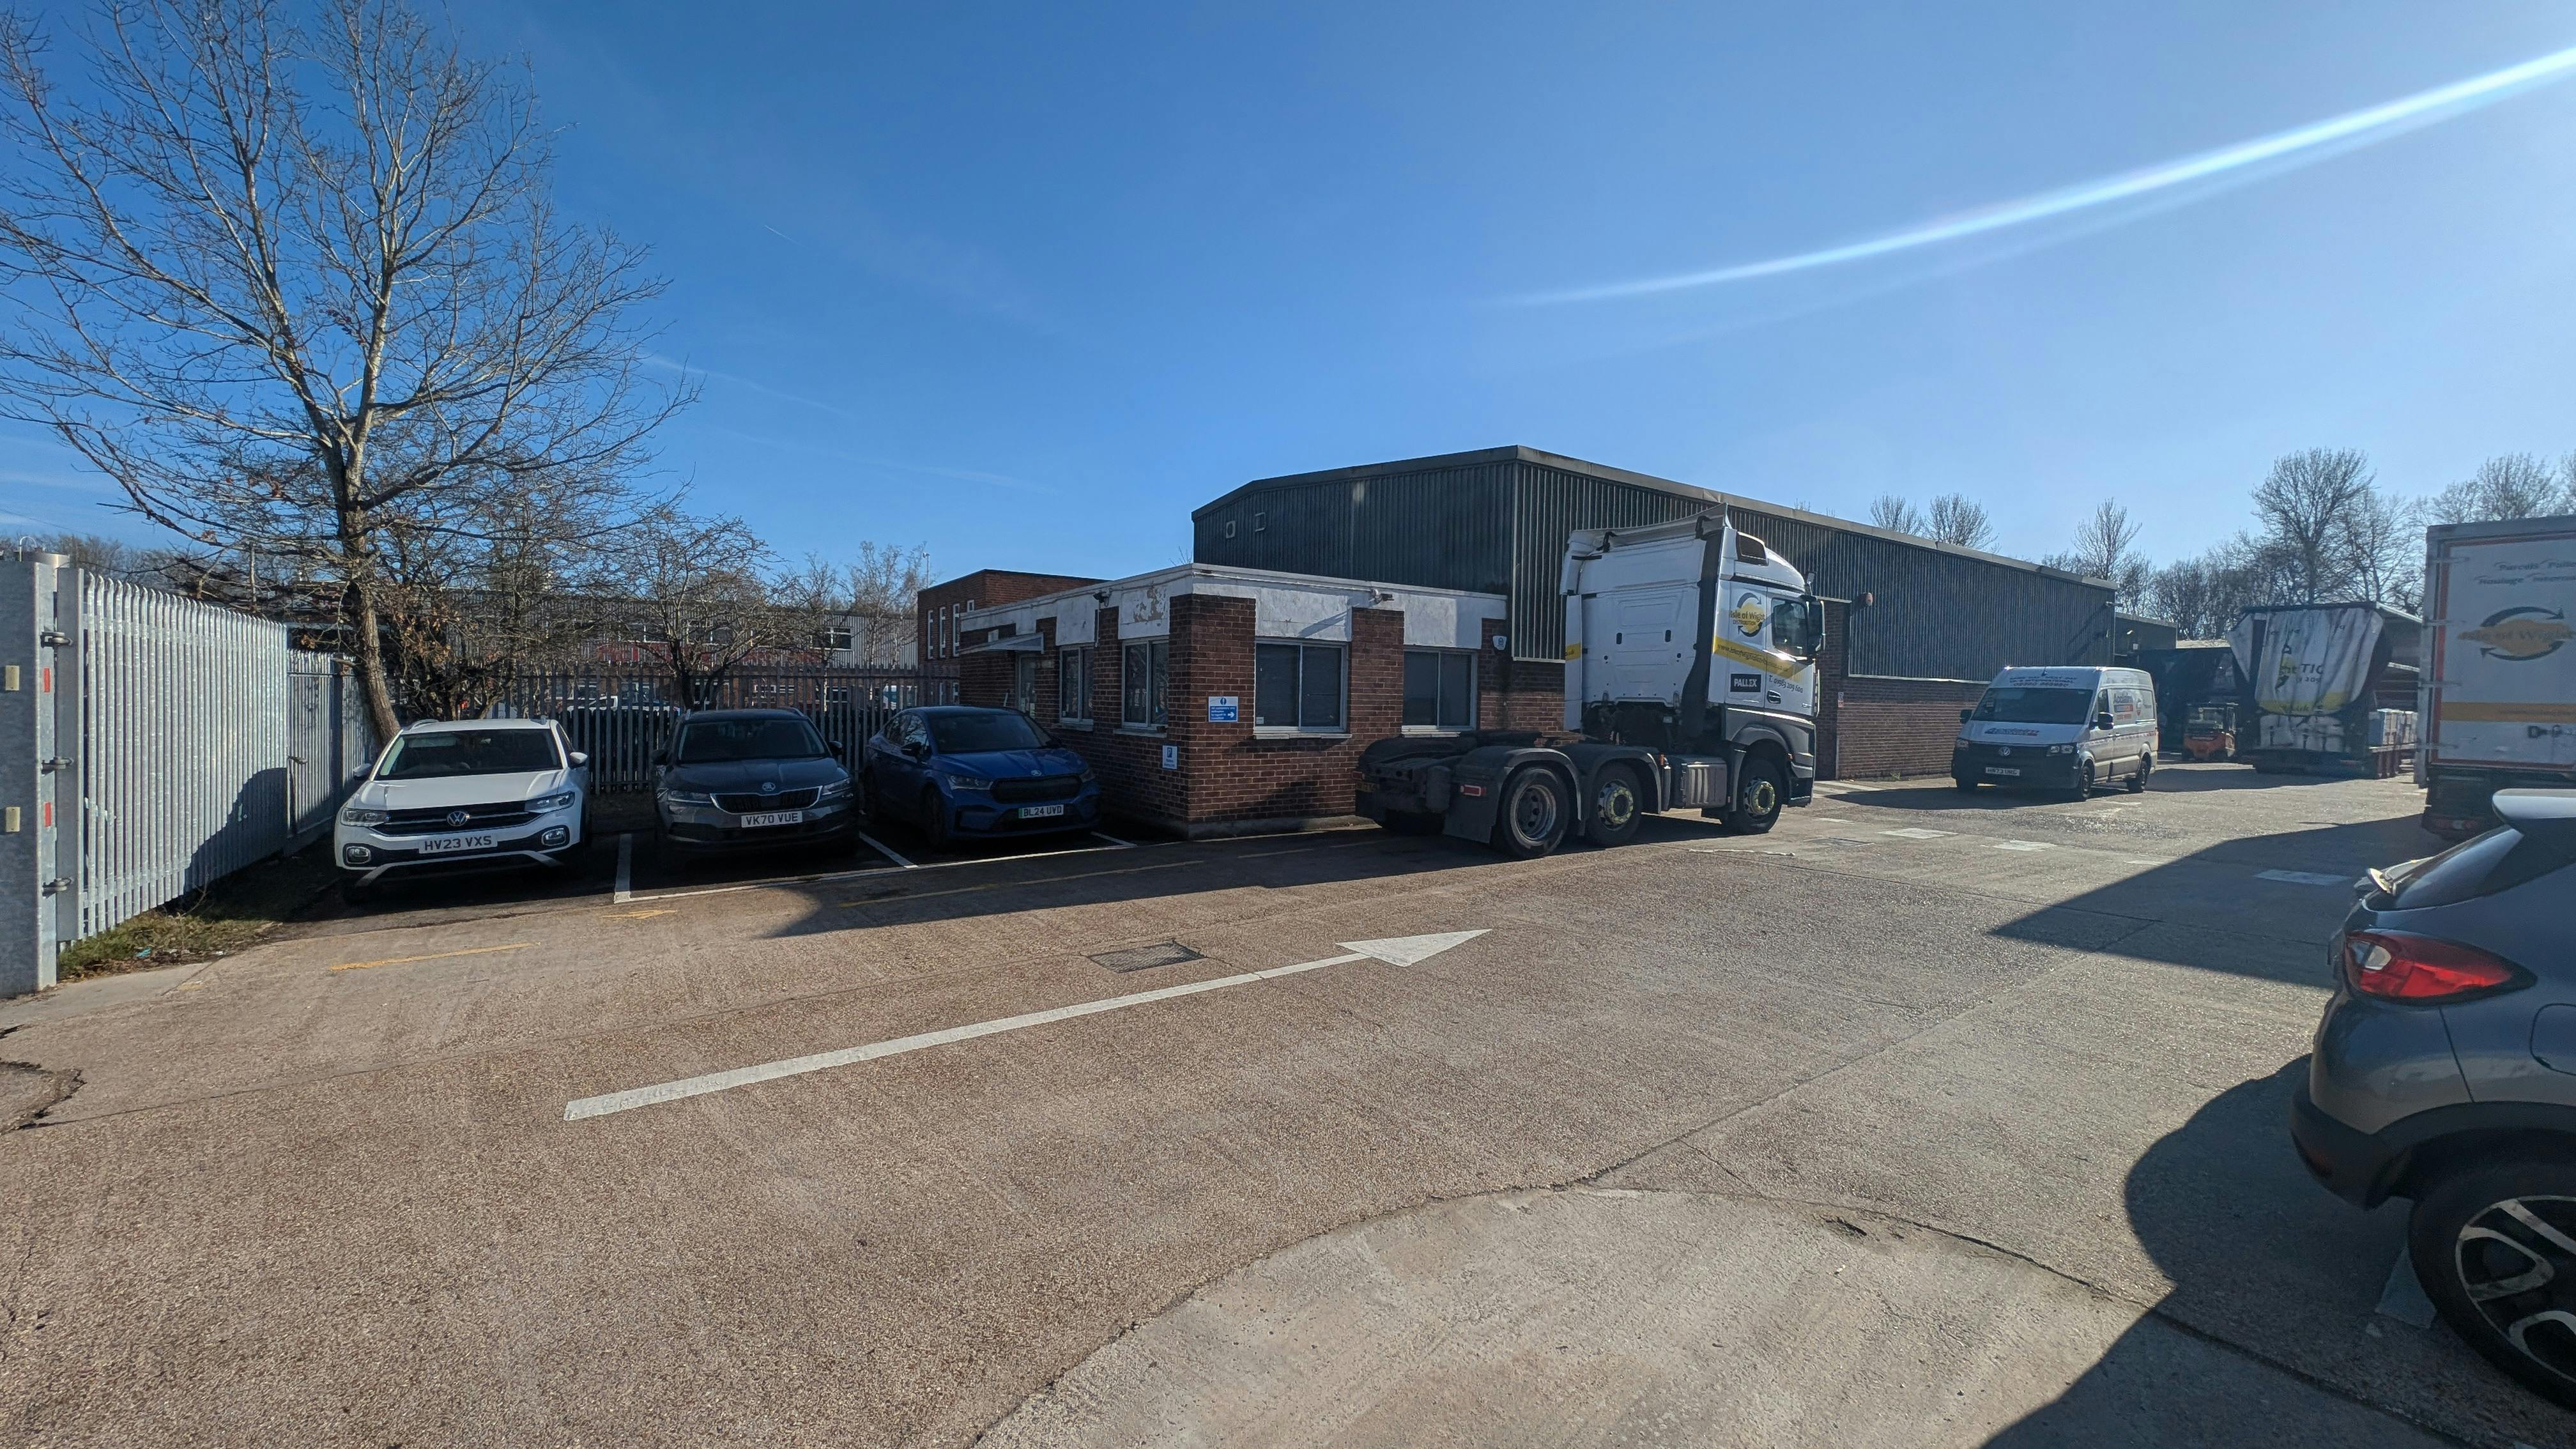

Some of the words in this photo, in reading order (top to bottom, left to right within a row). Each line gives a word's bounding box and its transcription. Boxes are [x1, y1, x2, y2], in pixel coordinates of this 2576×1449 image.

[1023, 808, 1045, 816] BL24
[1047, 806, 1062, 815] UVD
[746, 815, 774, 825] VK70
[778, 812, 798, 822] VUE
[424, 838, 461, 851] HV23
[465, 836, 492, 847] VXS
